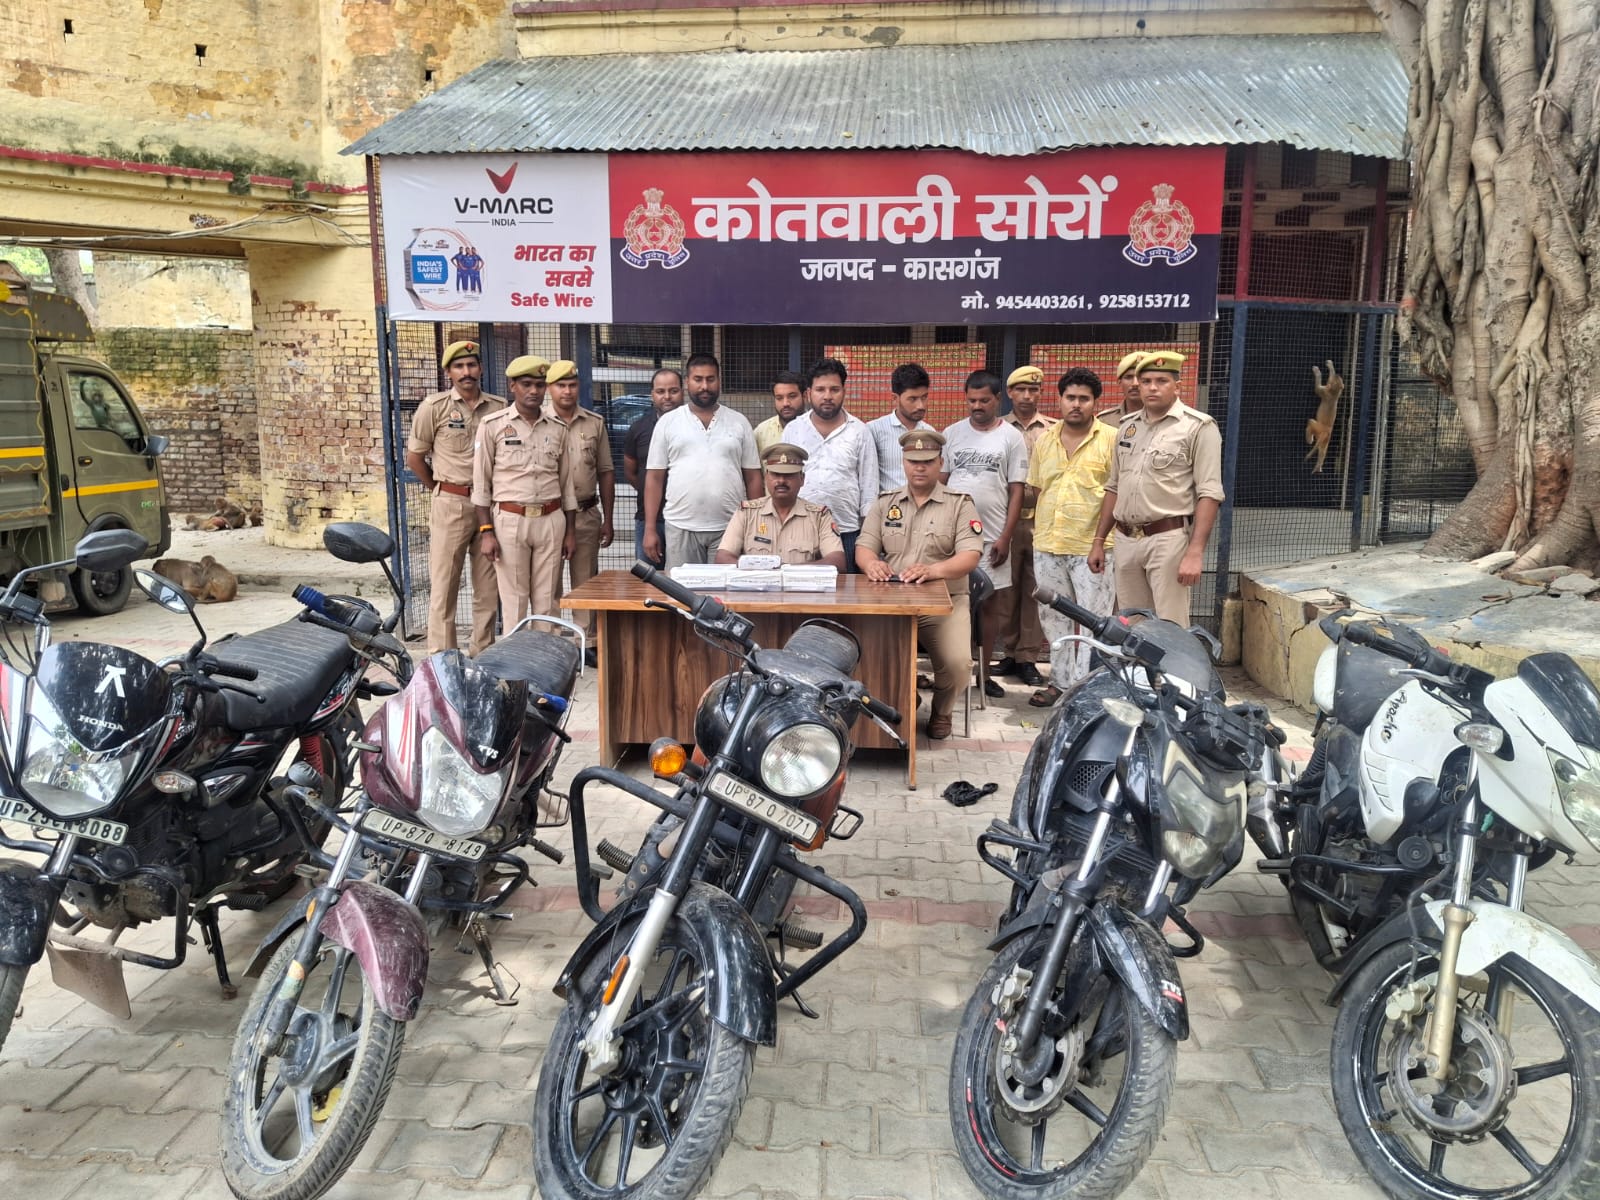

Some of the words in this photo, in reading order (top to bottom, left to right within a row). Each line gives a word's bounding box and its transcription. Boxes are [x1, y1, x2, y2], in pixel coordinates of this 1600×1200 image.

[454, 197, 554, 214] V-MARC
[692, 175, 960, 244] कोतवाली
[975, 175, 1119, 241] सोरों
[491, 218, 517, 227] INDIA
[514, 245, 565, 262] भारत
[568, 245, 597, 262] का
[800, 258, 876, 281] जनपद
[903, 248, 1002, 281] कासगंज
[545, 265, 594, 287] सबसे
[511, 292, 550, 307] Safe
[554, 292, 594, 308] Wire
[960, 290, 990, 310] मो.
[1099, 294, 1190, 309] 9258153712
[78, 714, 125, 732] HONDA
[478, 744, 499, 759] TVS
[725, 780, 743, 798] UP
[746, 793, 765, 810] 87
[778, 808, 811, 836] 7071
[0, 800, 24, 818] UP
[78, 820, 124, 841] 8088
[381, 817, 402, 833] UP
[446, 839, 482, 857] 8149
